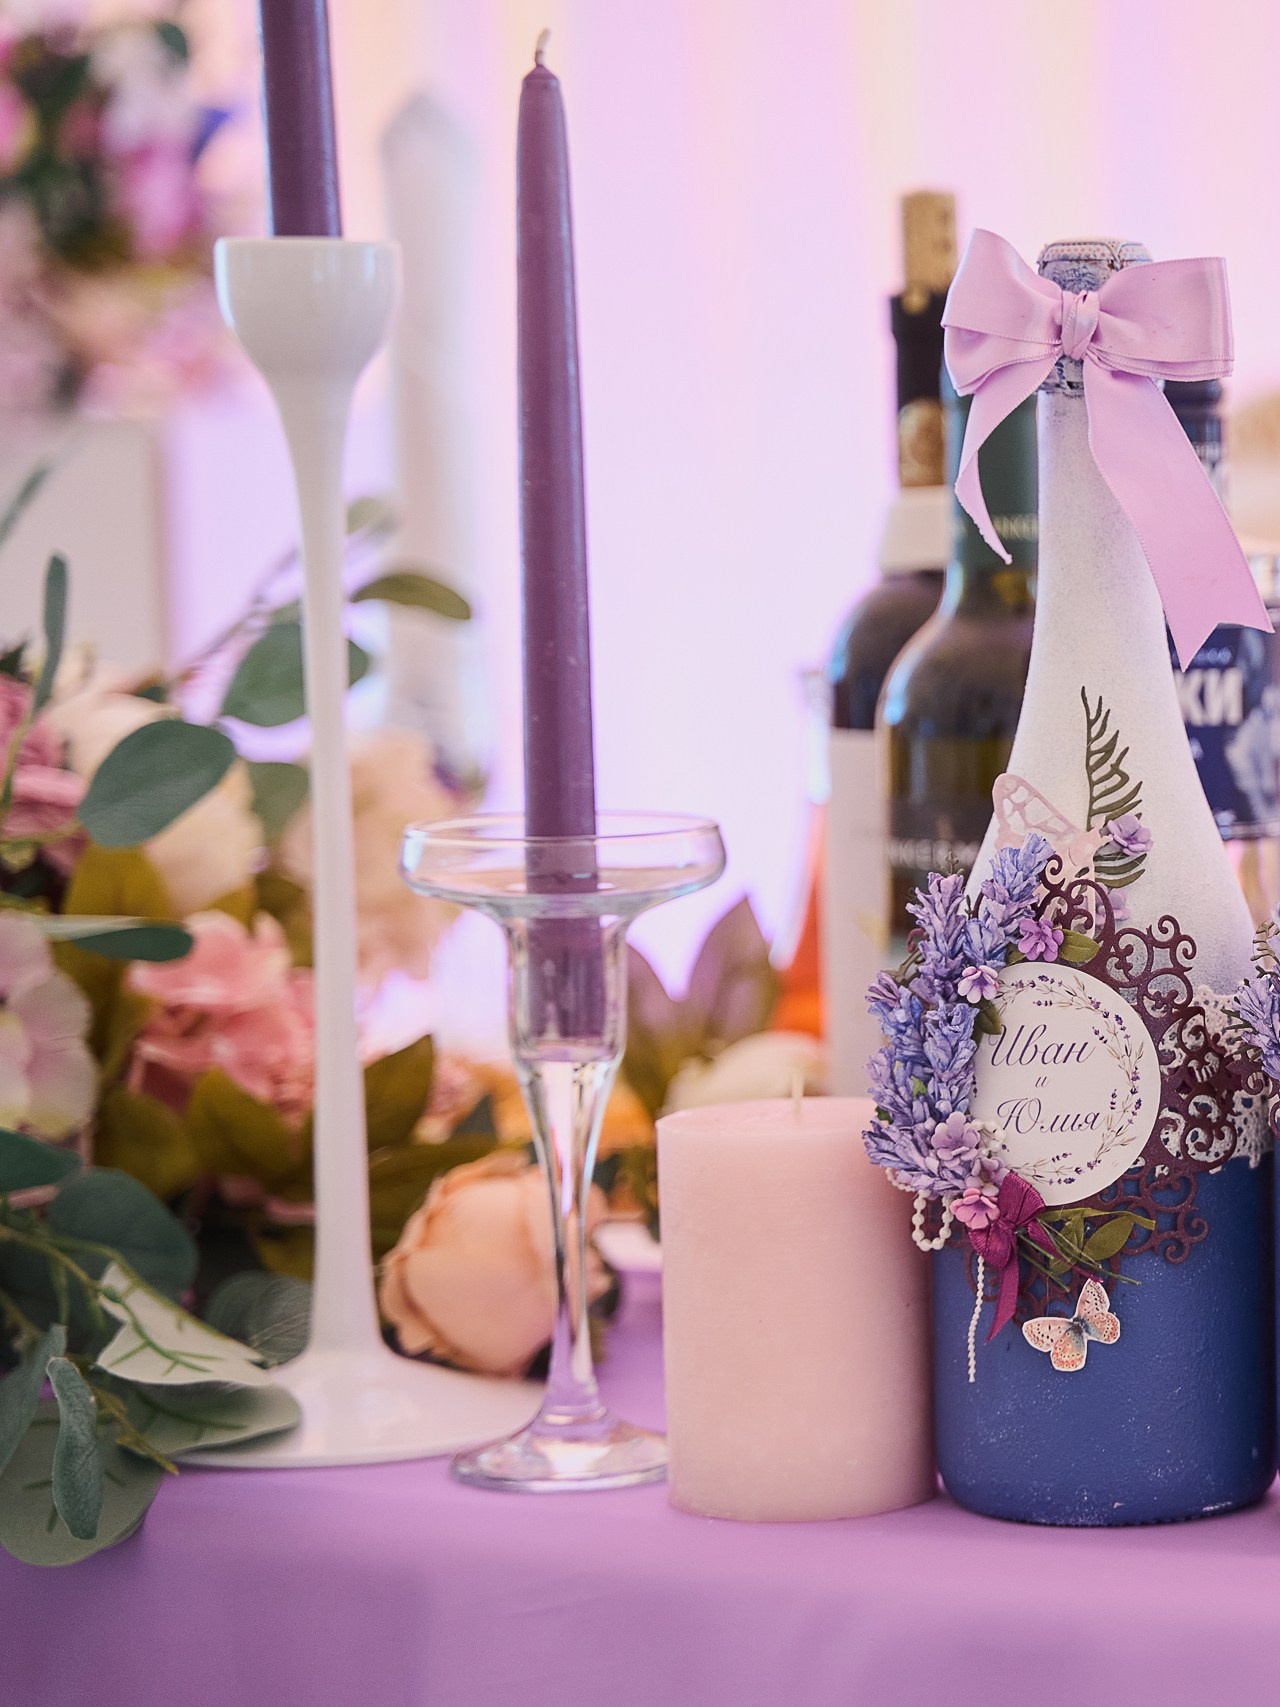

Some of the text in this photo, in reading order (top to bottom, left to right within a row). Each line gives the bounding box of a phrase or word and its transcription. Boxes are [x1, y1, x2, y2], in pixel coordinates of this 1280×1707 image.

[988, 1024, 1096, 1067] Иван
[1035, 1075, 1050, 1088] и
[997, 1098, 1103, 1134] Юлия
